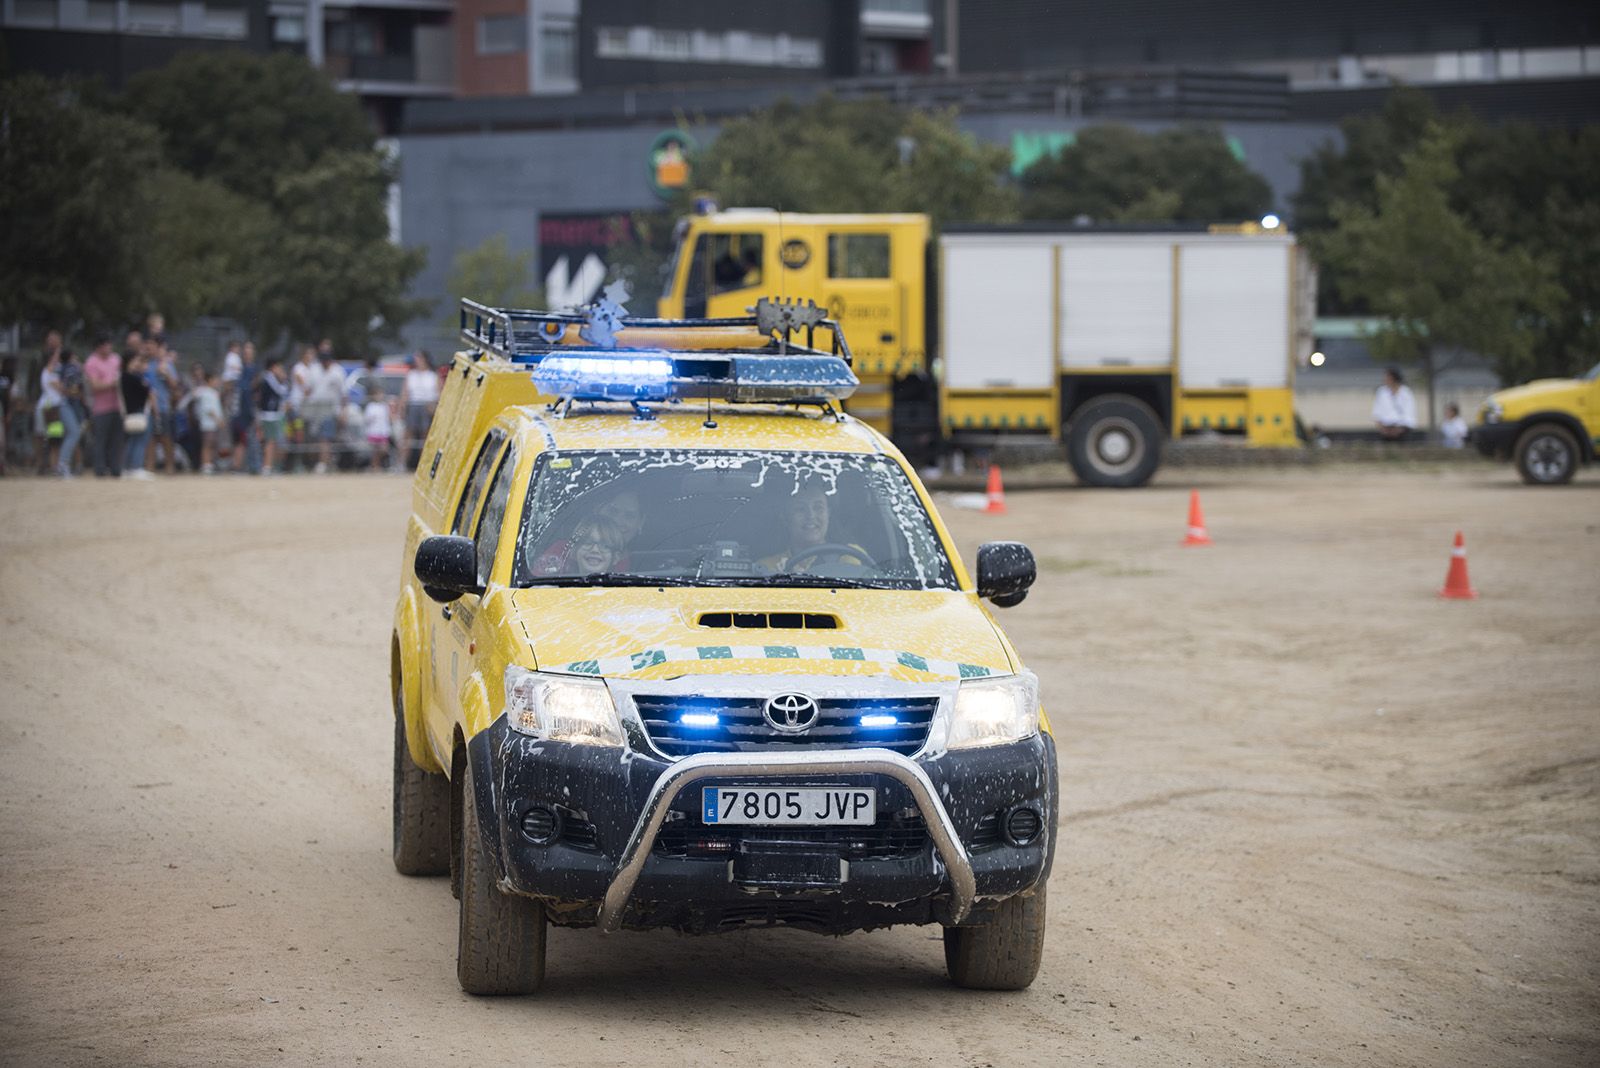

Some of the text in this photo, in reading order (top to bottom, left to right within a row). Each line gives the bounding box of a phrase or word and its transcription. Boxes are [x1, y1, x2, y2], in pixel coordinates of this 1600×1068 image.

[707, 808, 715, 817] E
[722, 792, 870, 820] 7805 JVP
